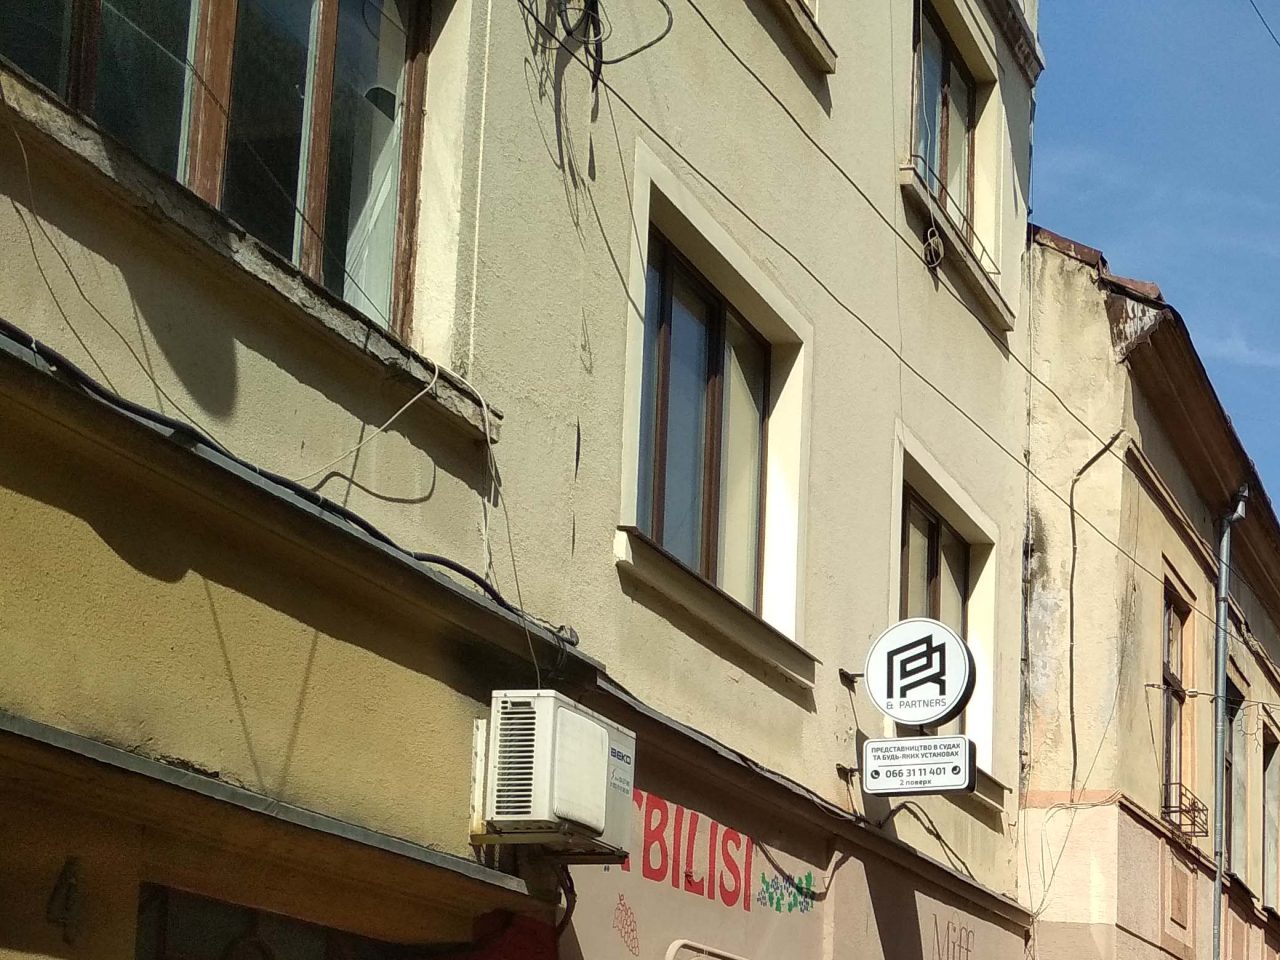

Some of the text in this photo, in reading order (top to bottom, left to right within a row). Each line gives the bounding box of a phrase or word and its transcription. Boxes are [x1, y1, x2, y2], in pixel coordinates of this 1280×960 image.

[899, 698, 947, 710] PARTNERS
[871, 744, 932, 753] ПРЕДСТАВНИЦТВО
[610, 747, 632, 766] BEKO
[920, 751, 959, 759] УСТАНОВАХ
[885, 767, 946, 778] 066 31 11 401
[620, 788, 753, 912] BILISI
